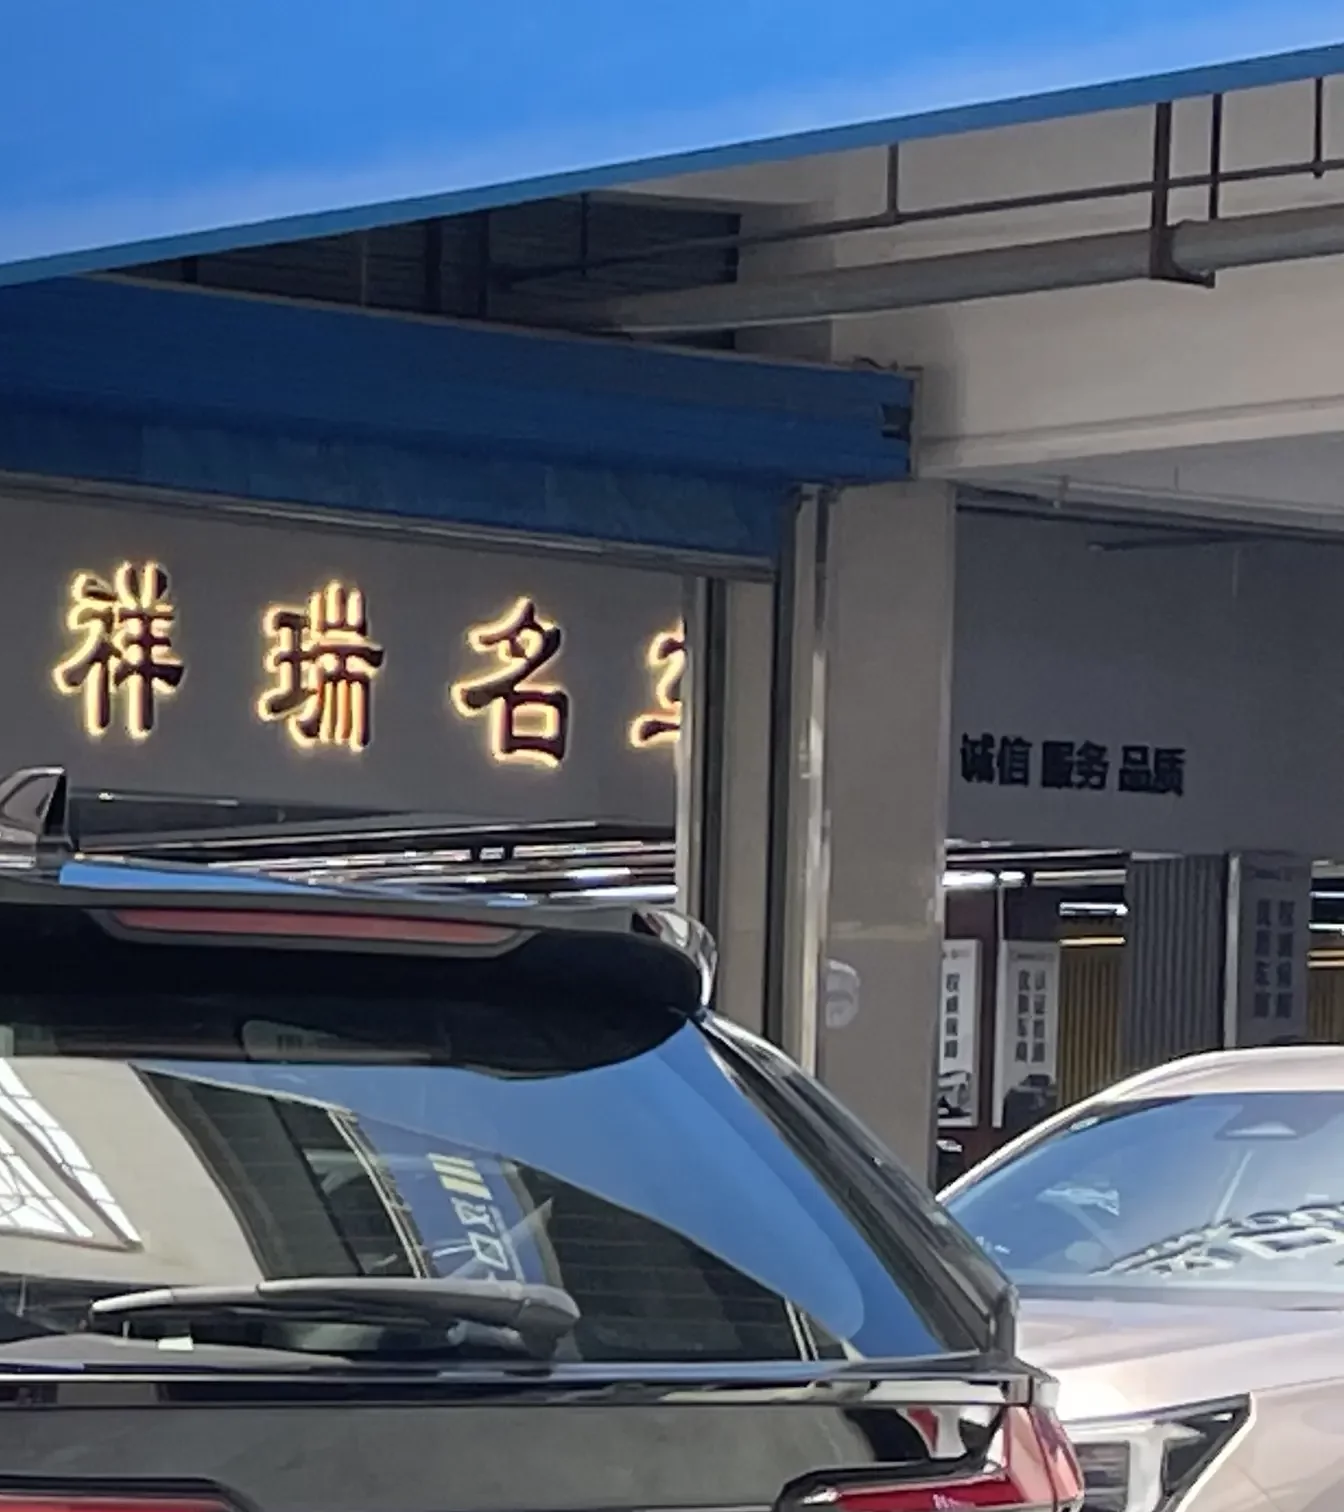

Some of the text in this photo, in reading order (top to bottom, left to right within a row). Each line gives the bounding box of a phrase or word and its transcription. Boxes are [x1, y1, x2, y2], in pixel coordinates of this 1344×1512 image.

[959, 731, 1187, 797] 诚信 服务 品质
